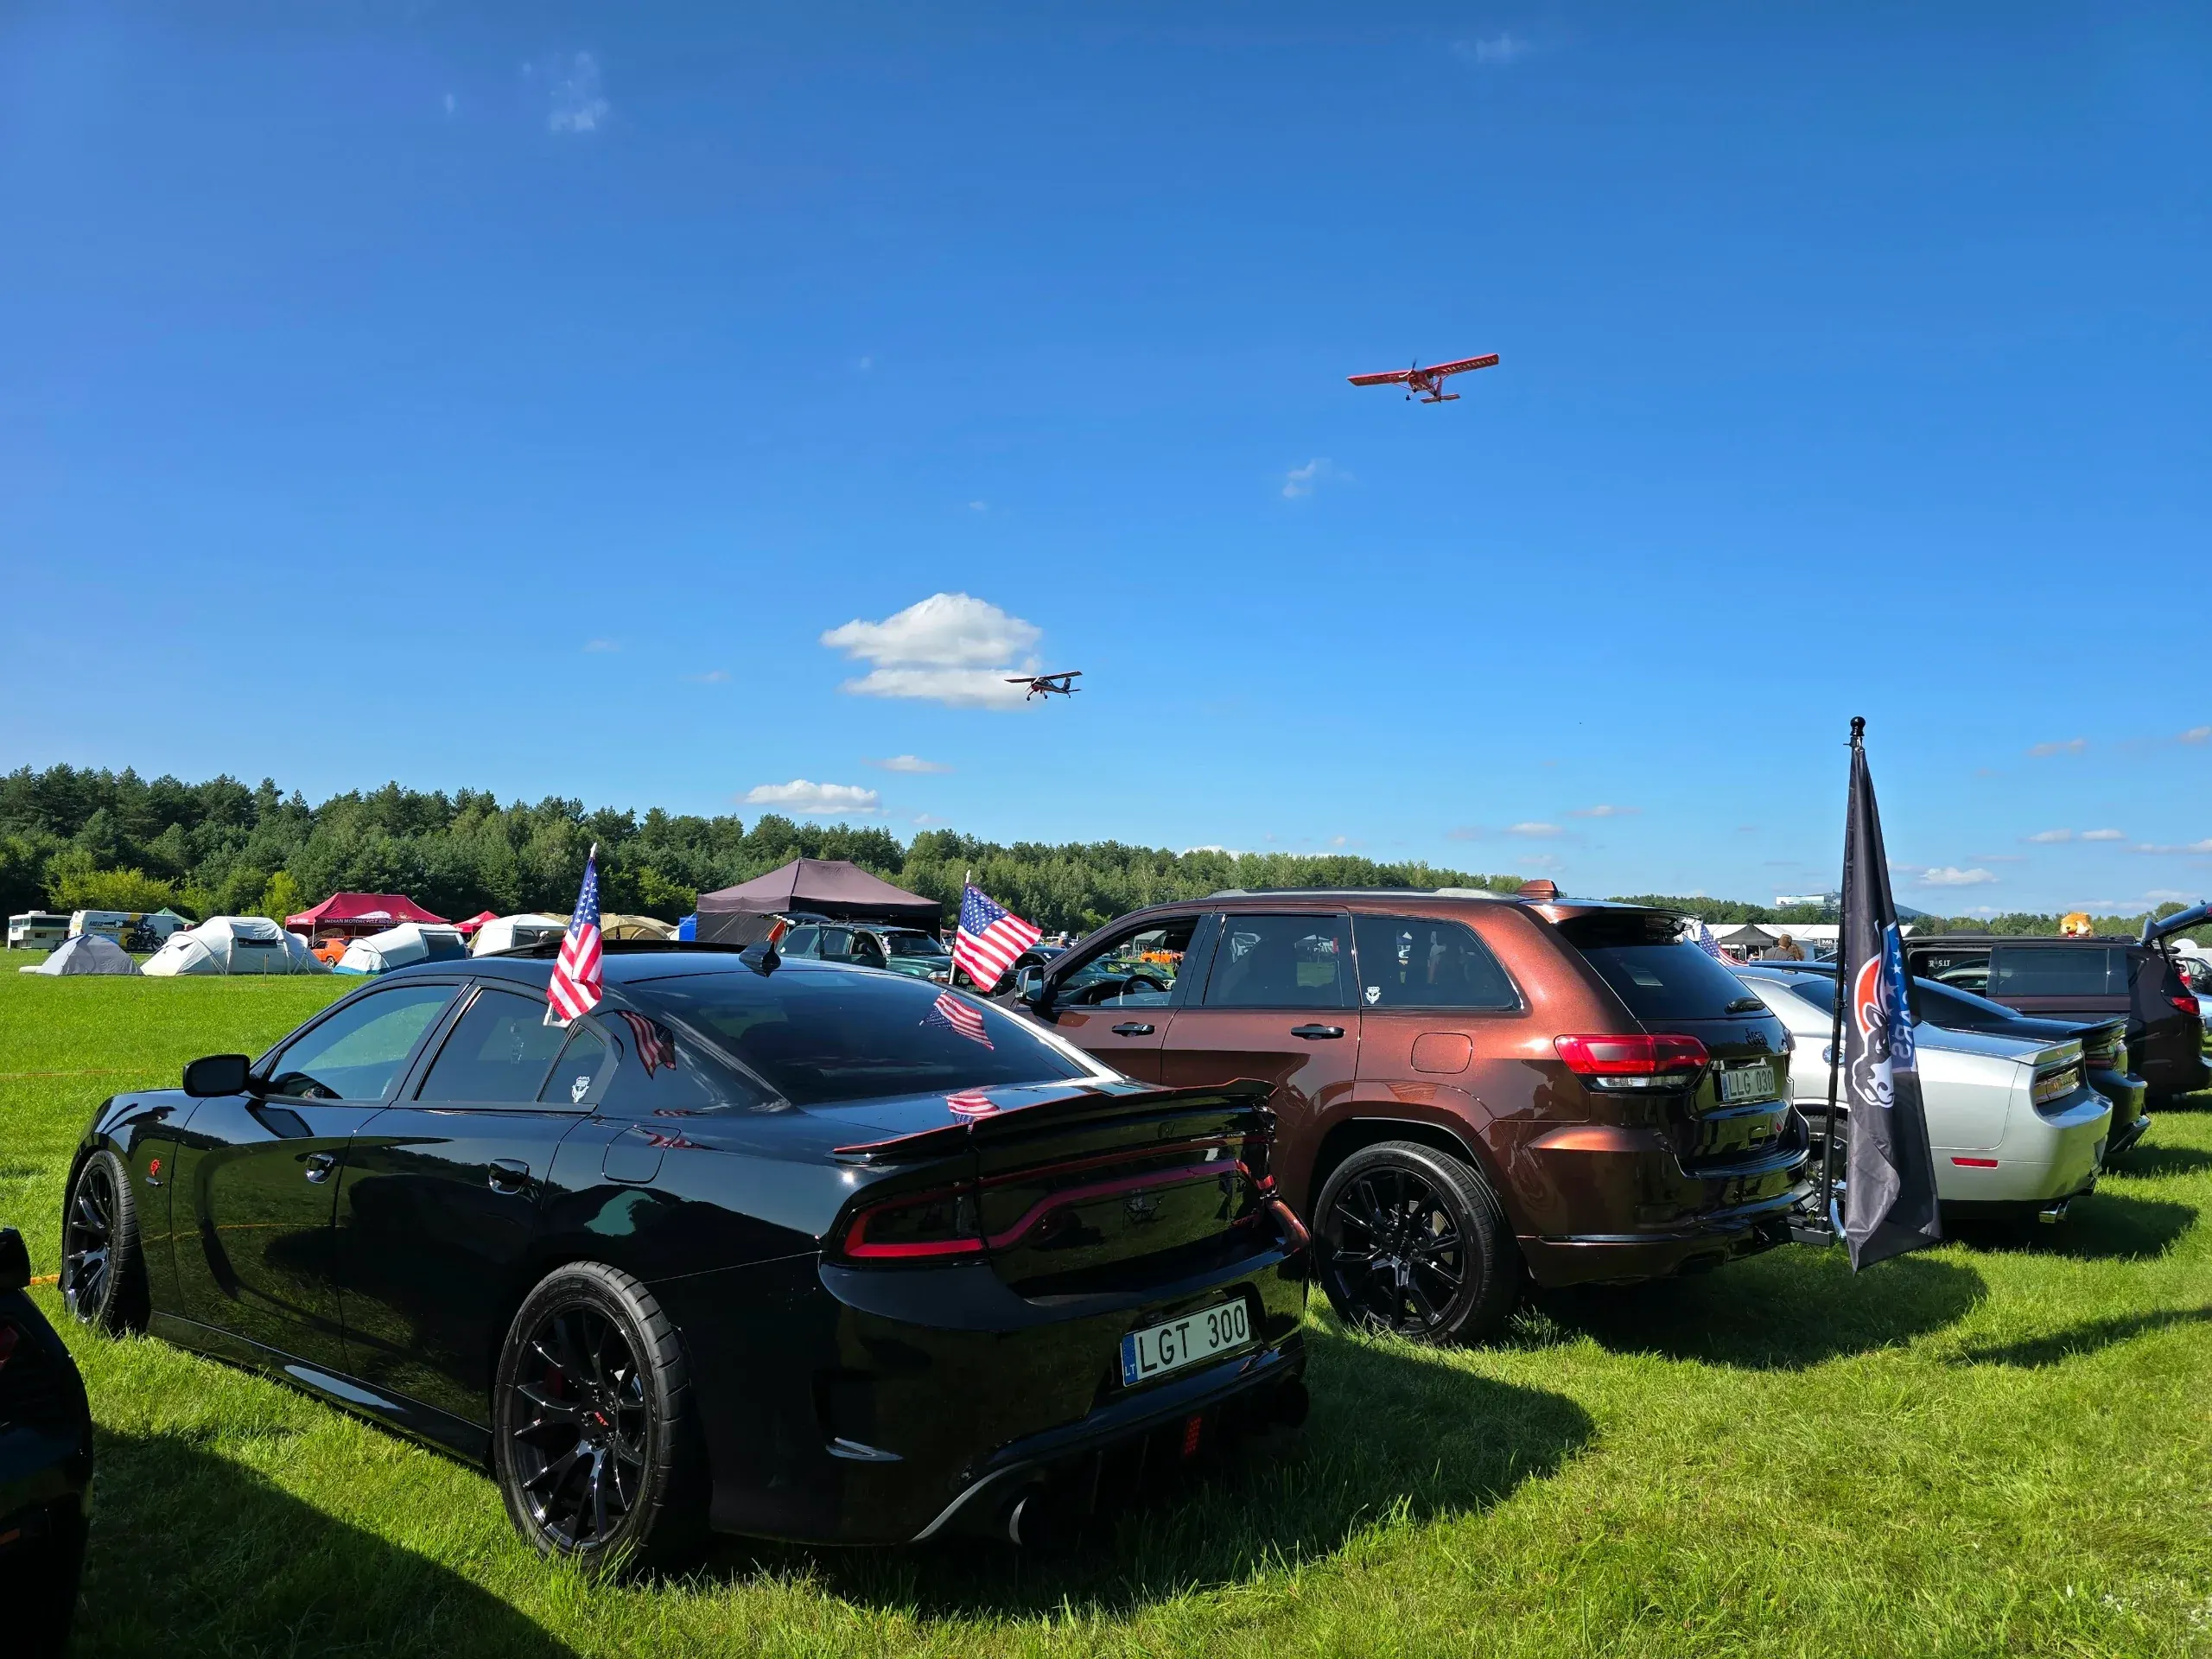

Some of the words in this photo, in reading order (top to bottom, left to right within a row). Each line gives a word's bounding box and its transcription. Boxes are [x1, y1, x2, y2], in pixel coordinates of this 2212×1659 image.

[1727, 1072, 1751, 1096] LLG
[1756, 1070, 1774, 1093] 030
[1125, 1363, 1135, 1377] LT
[1139, 1321, 1190, 1374] LGT
[1207, 1305, 1246, 1349] 300
